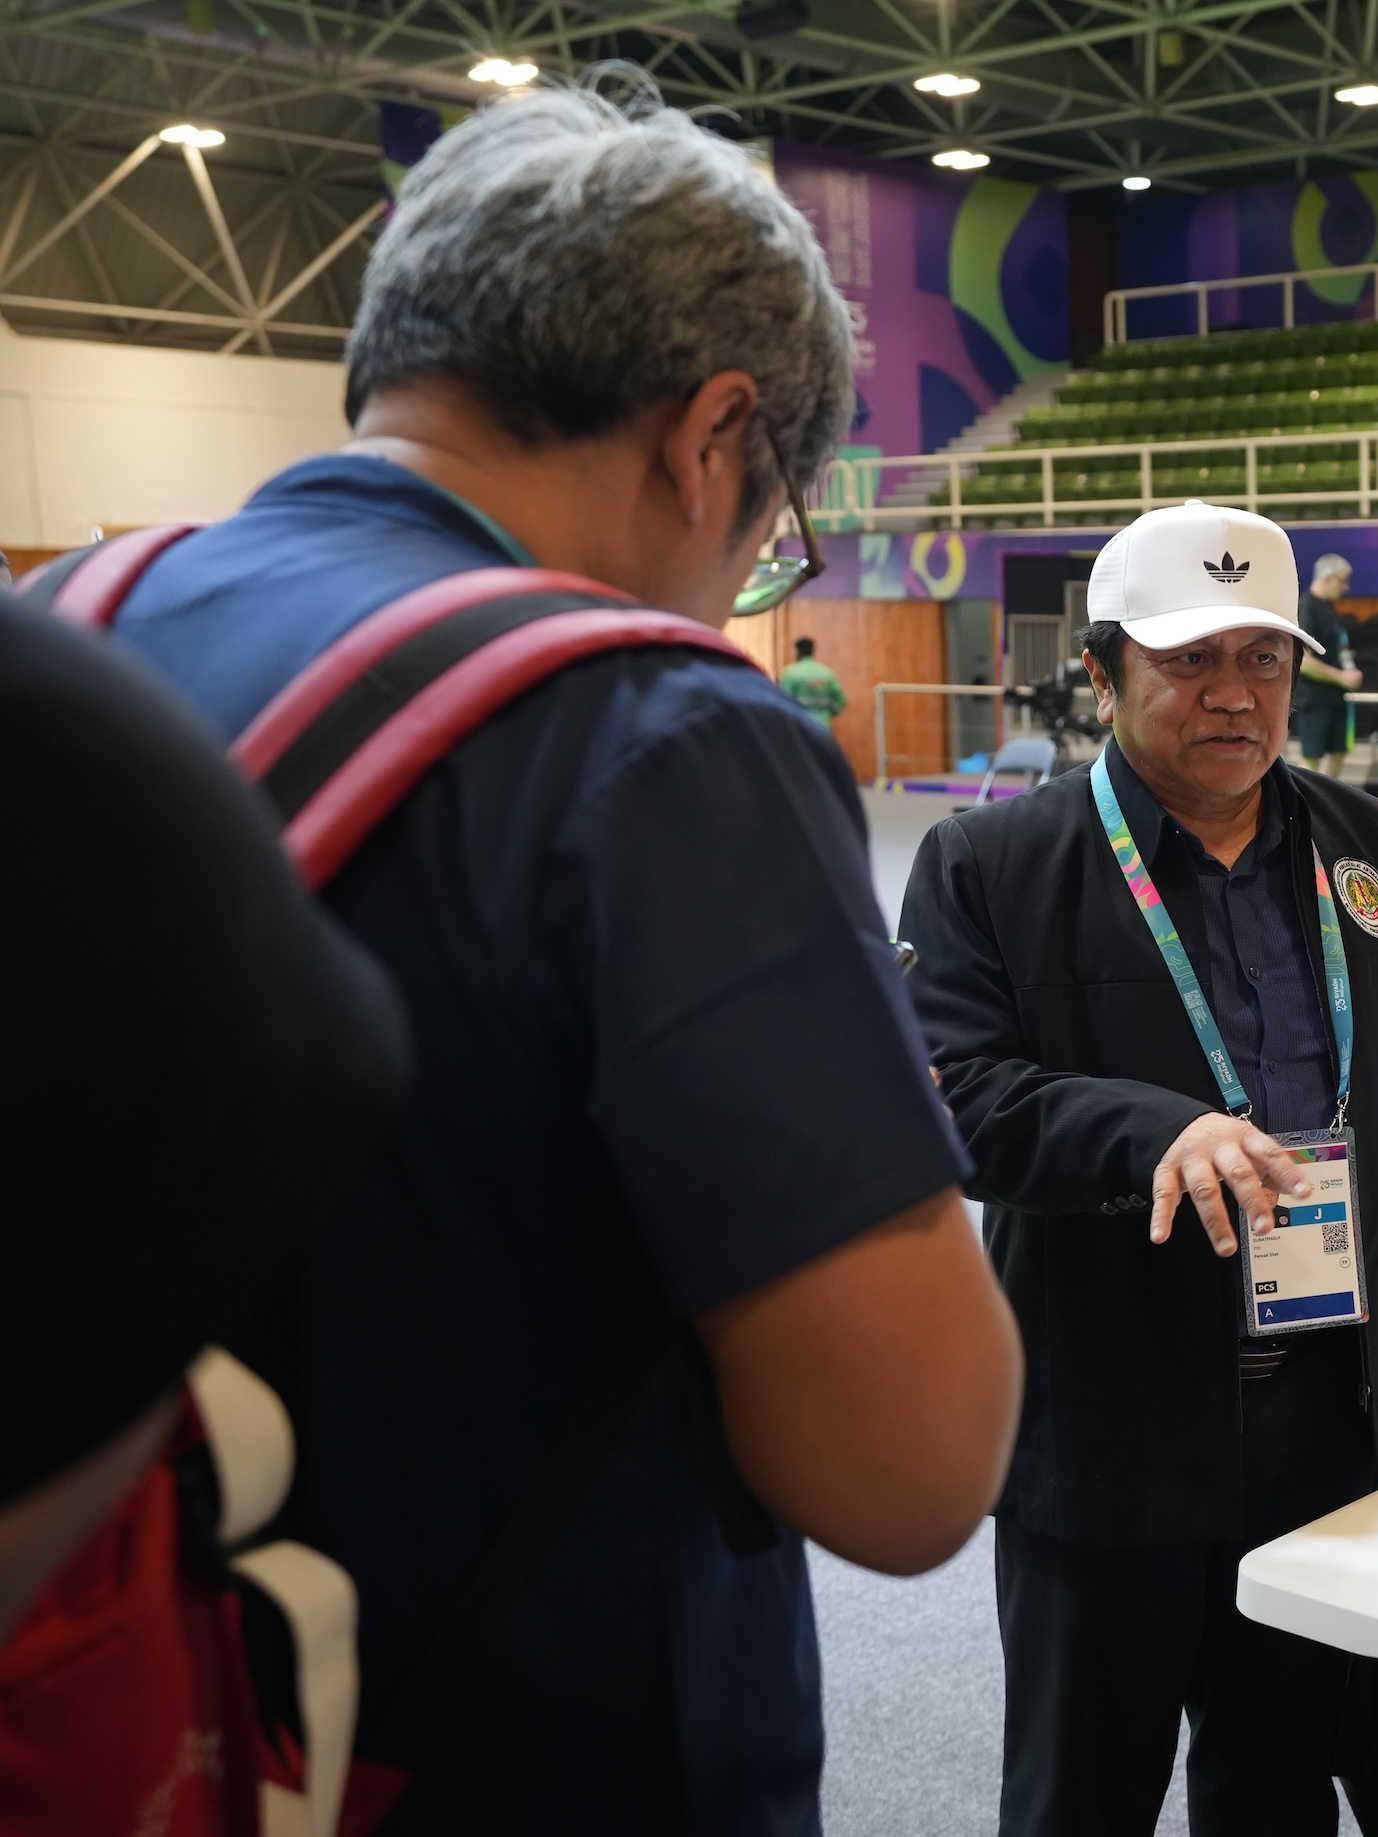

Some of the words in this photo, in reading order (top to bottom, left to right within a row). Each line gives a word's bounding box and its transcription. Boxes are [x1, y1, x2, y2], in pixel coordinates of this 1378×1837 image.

[1314, 1208, 1322, 1220] J
[1258, 1283, 1275, 1292] PCS
[1265, 1308, 1274, 1318] A
